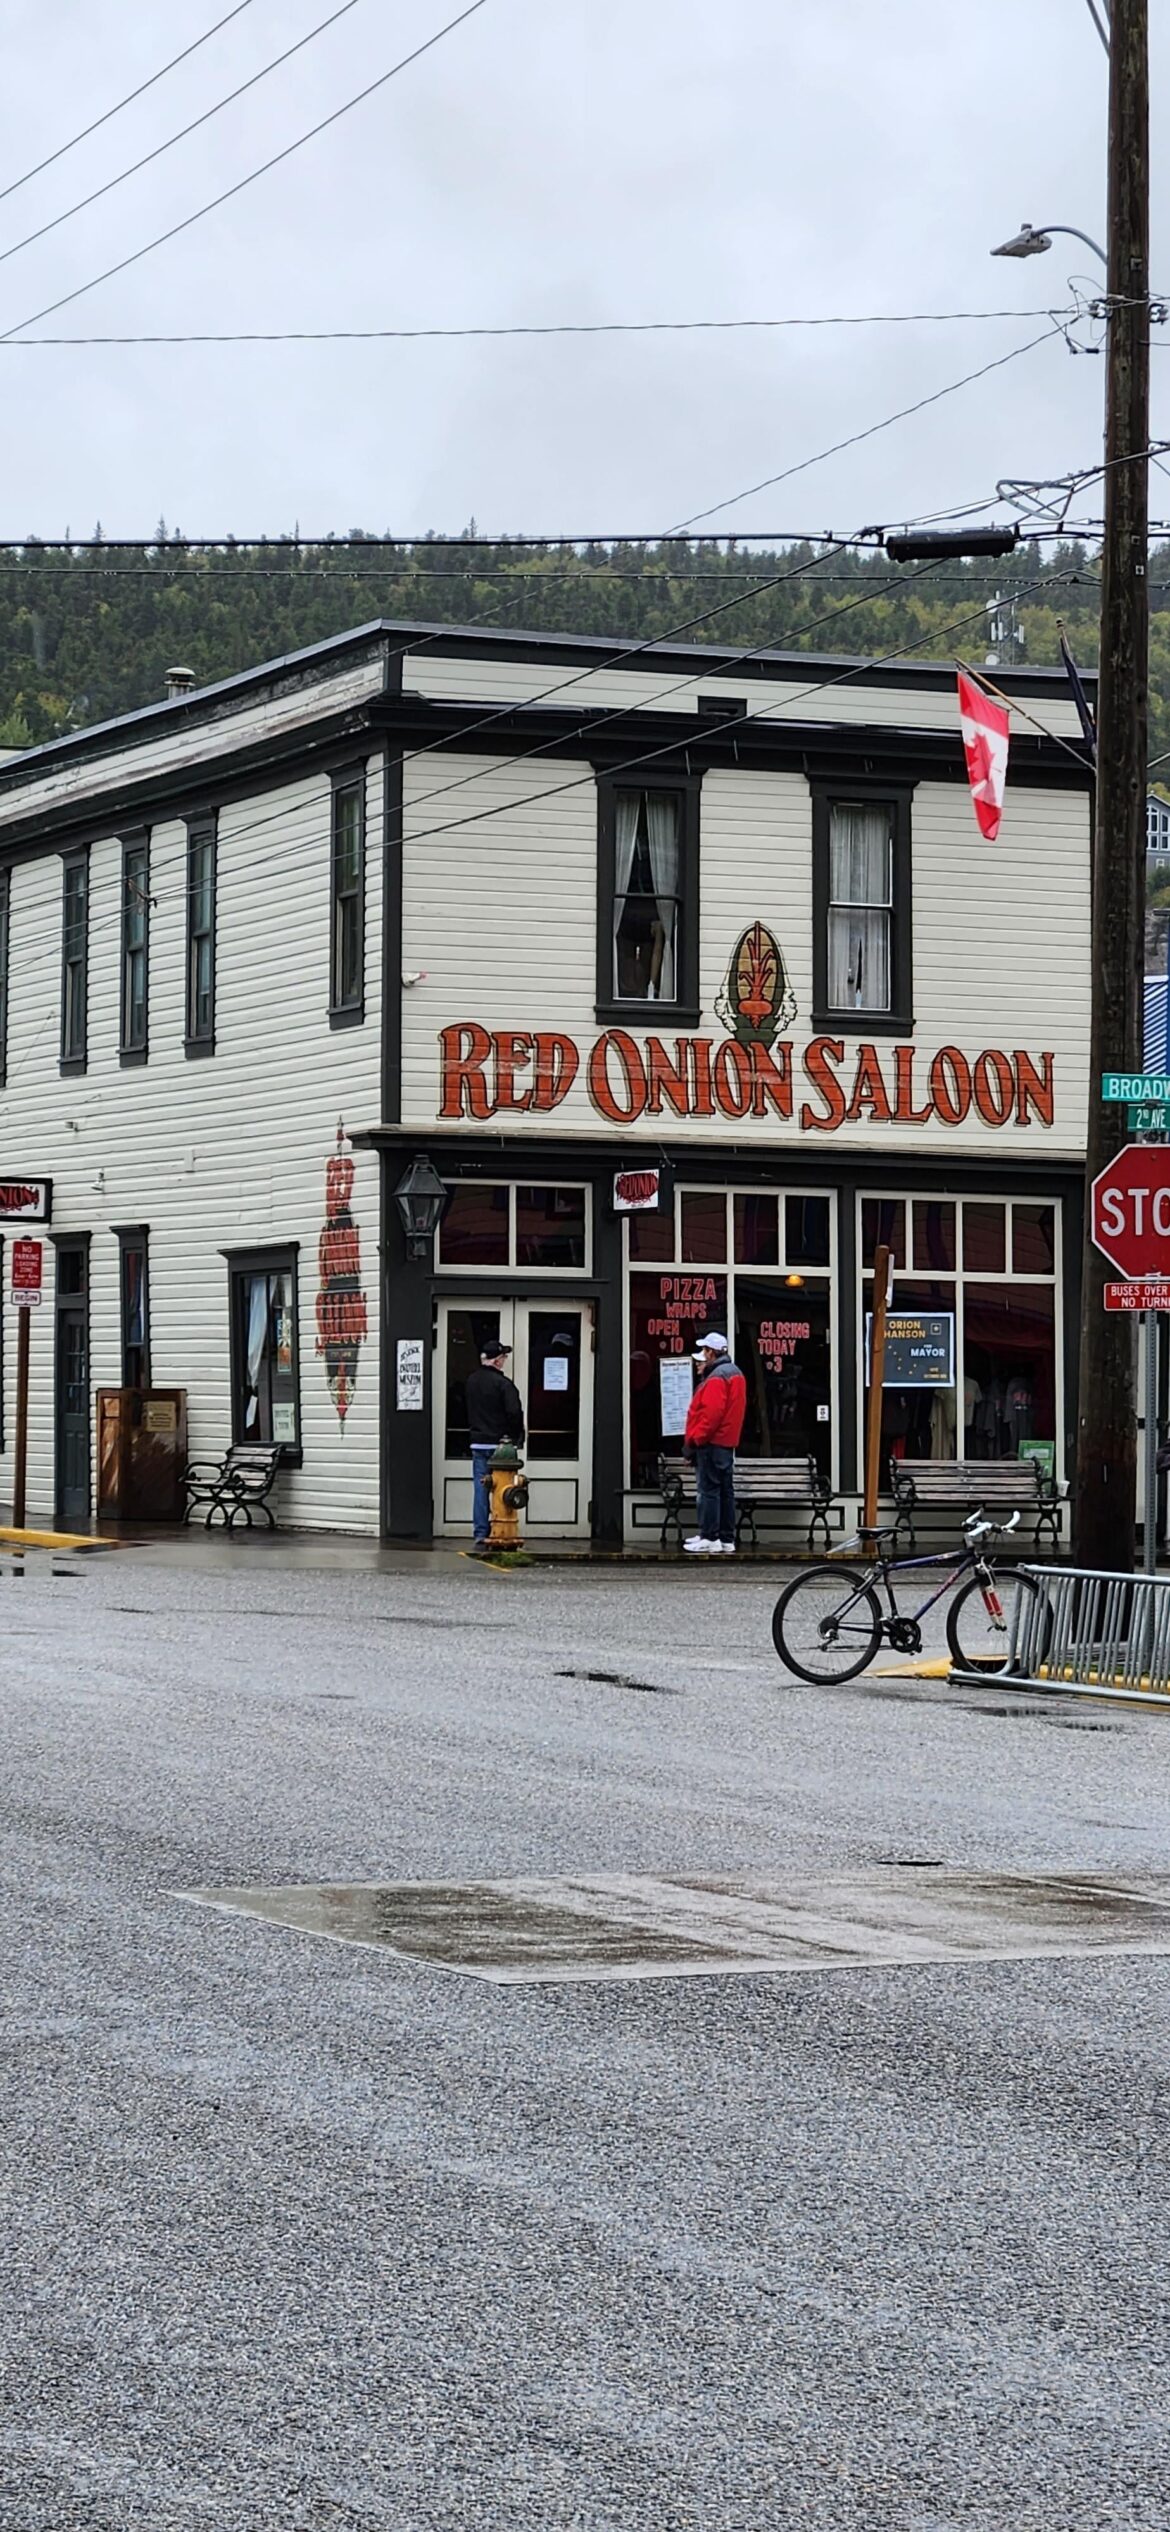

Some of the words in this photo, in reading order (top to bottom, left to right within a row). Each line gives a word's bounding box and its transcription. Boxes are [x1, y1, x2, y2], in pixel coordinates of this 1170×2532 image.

[437, 1022, 579, 1121] RED
[587, 1029, 793, 1127] ONION
[800, 1037, 1054, 1133] SALOON
[1151, 1109, 1166, 1128] AVE
[22, 1245, 32, 1253] NO
[660, 1277, 717, 1300] PIZZA
[1110, 1285, 1140, 1297] BUSES
[1144, 1285, 1168, 1297] OVER
[15, 1294, 38, 1302] BEGIN
[1121, 1297, 1136, 1308] NO
[666, 1302, 707, 1319] WRAPS
[647, 1319, 680, 1336] OPEN
[760, 1321, 810, 1339] CLOSING
[889, 1321, 920, 1329] ORION
[884, 1330, 925, 1338] HANSON
[670, 1337, 684, 1353] 10
[757, 1338, 796, 1356] TODAY
[911, 1348, 945, 1357] MAYOR
[773, 1356, 783, 1373] 3
